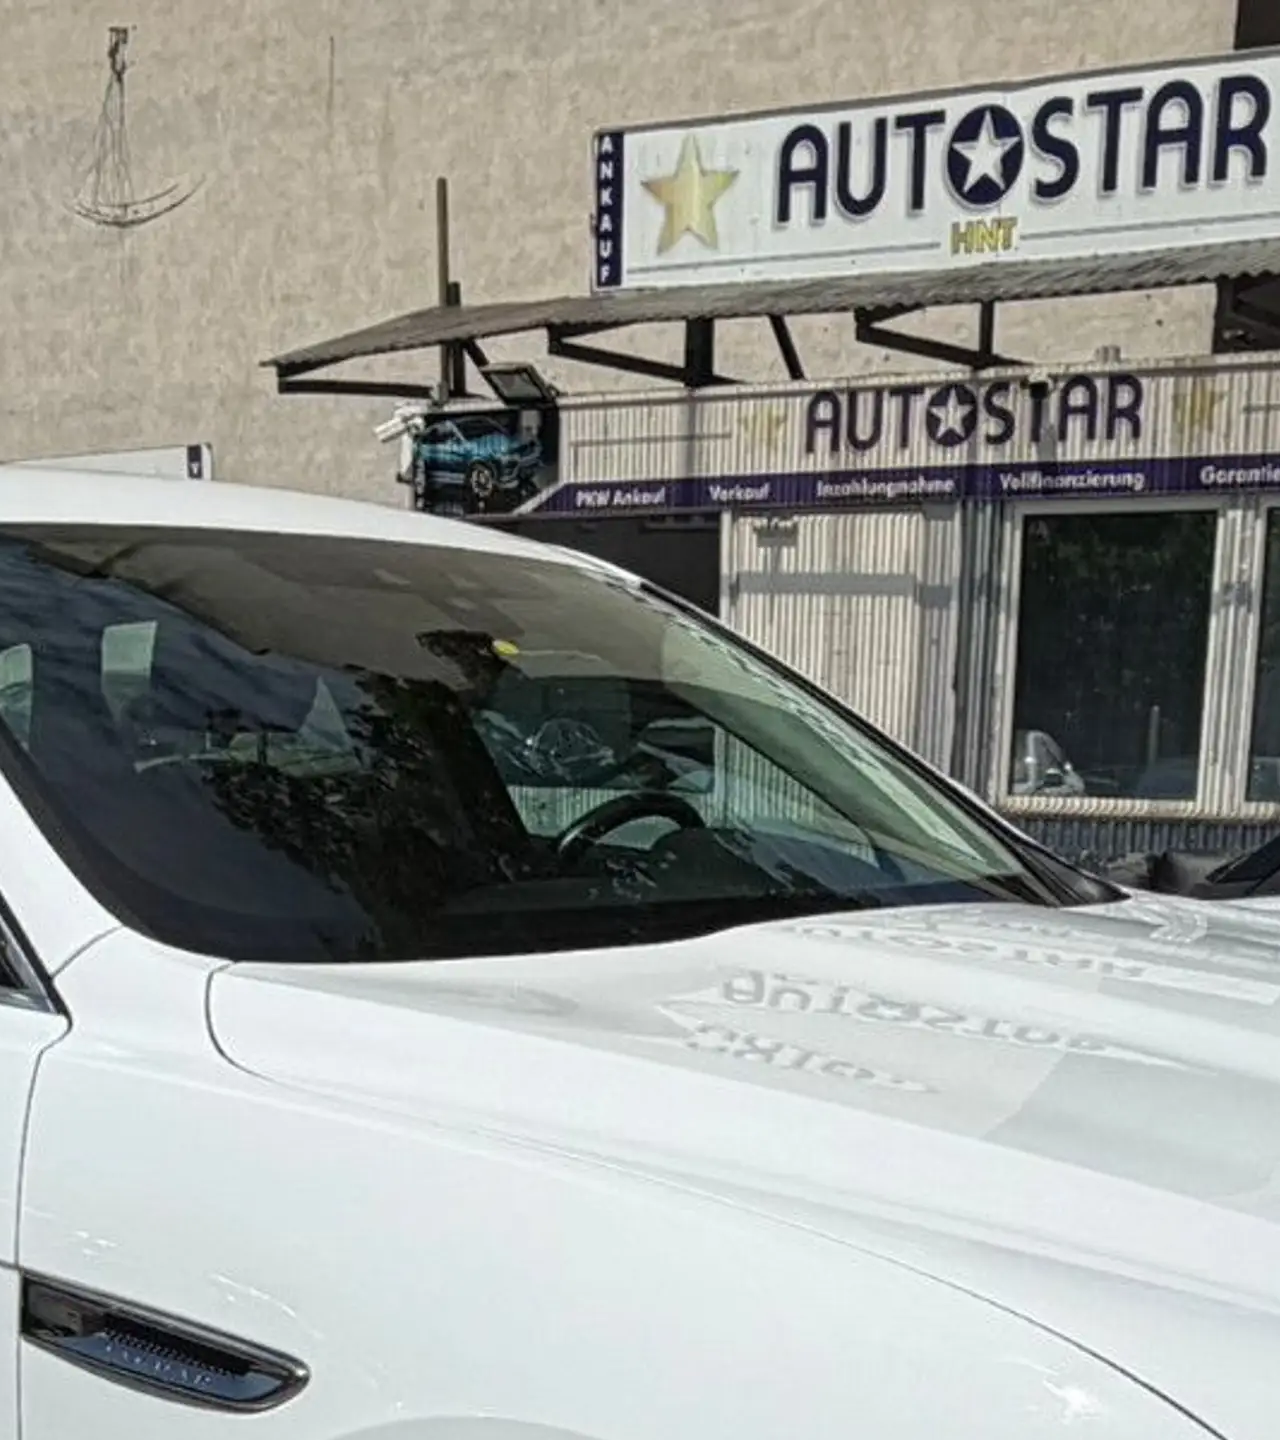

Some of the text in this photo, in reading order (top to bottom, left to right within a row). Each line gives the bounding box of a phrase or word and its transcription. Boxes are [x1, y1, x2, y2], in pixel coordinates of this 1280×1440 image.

[776, 74, 1272, 225] AUTOSTAR
[599, 134, 614, 284] ANKAUF
[805, 373, 1144, 455] AUTOSTAR
[575, 488, 610, 508] PKW
[708, 482, 771, 501] Verkauf
[999, 468, 1146, 491] Vollfinanzierung
